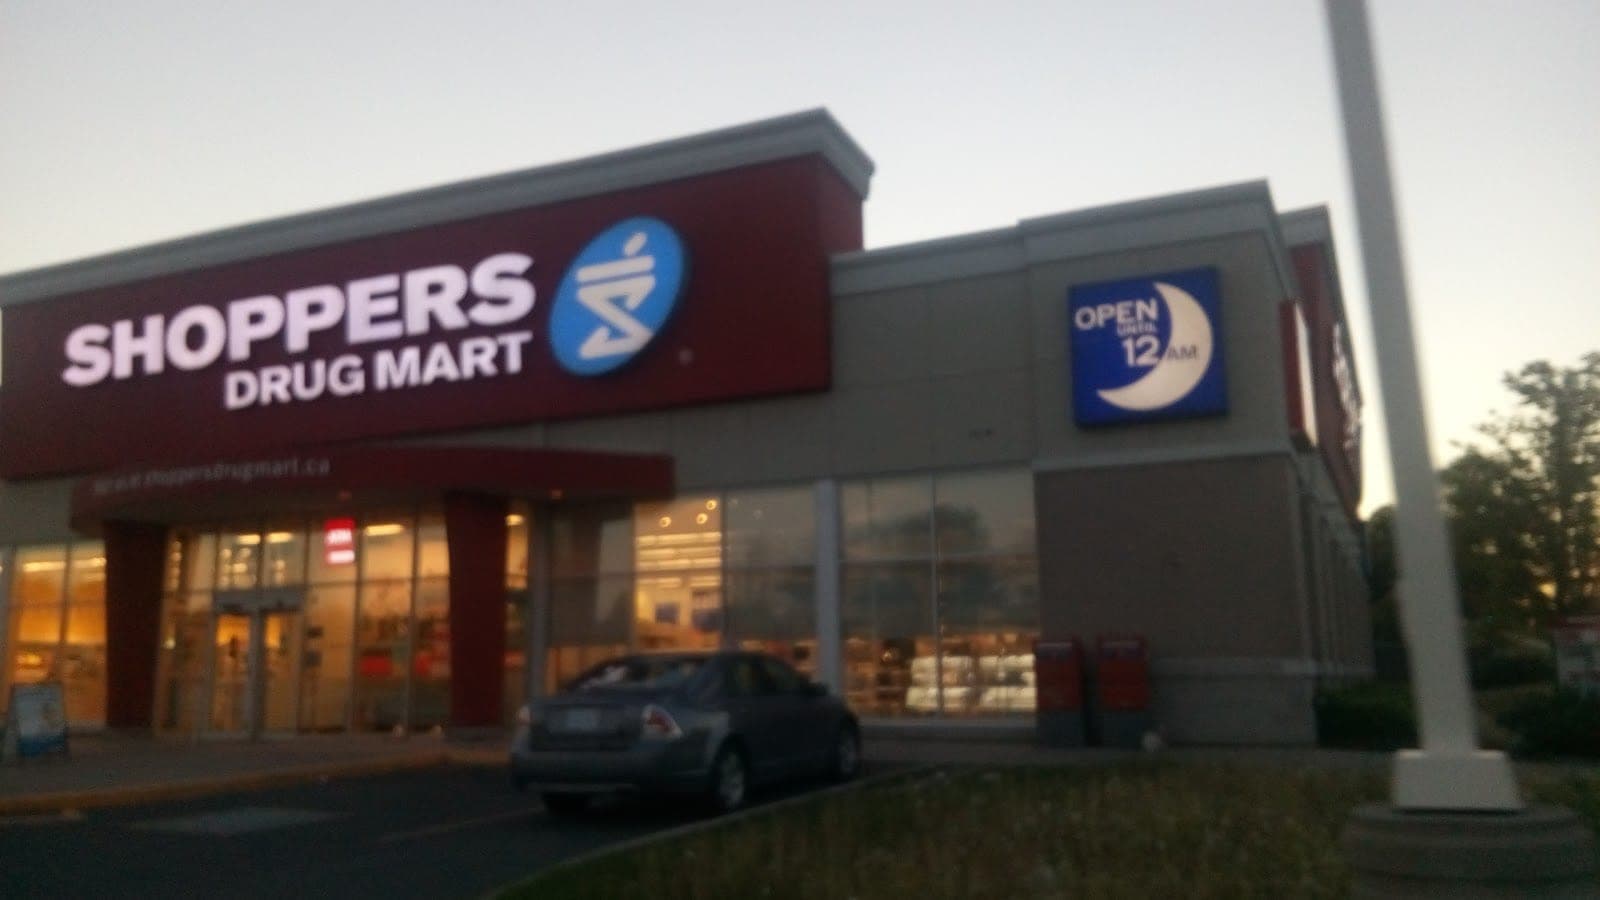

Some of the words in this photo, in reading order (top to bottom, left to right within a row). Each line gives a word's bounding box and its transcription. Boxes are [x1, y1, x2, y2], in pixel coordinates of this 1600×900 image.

[62, 253, 536, 387] SHOPPERS
[1074, 298, 1158, 330] OPEN
[223, 355, 366, 410] DRUG
[374, 331, 534, 391] MART
[1123, 335, 1160, 367] 12
[1167, 344, 1198, 360] AM
